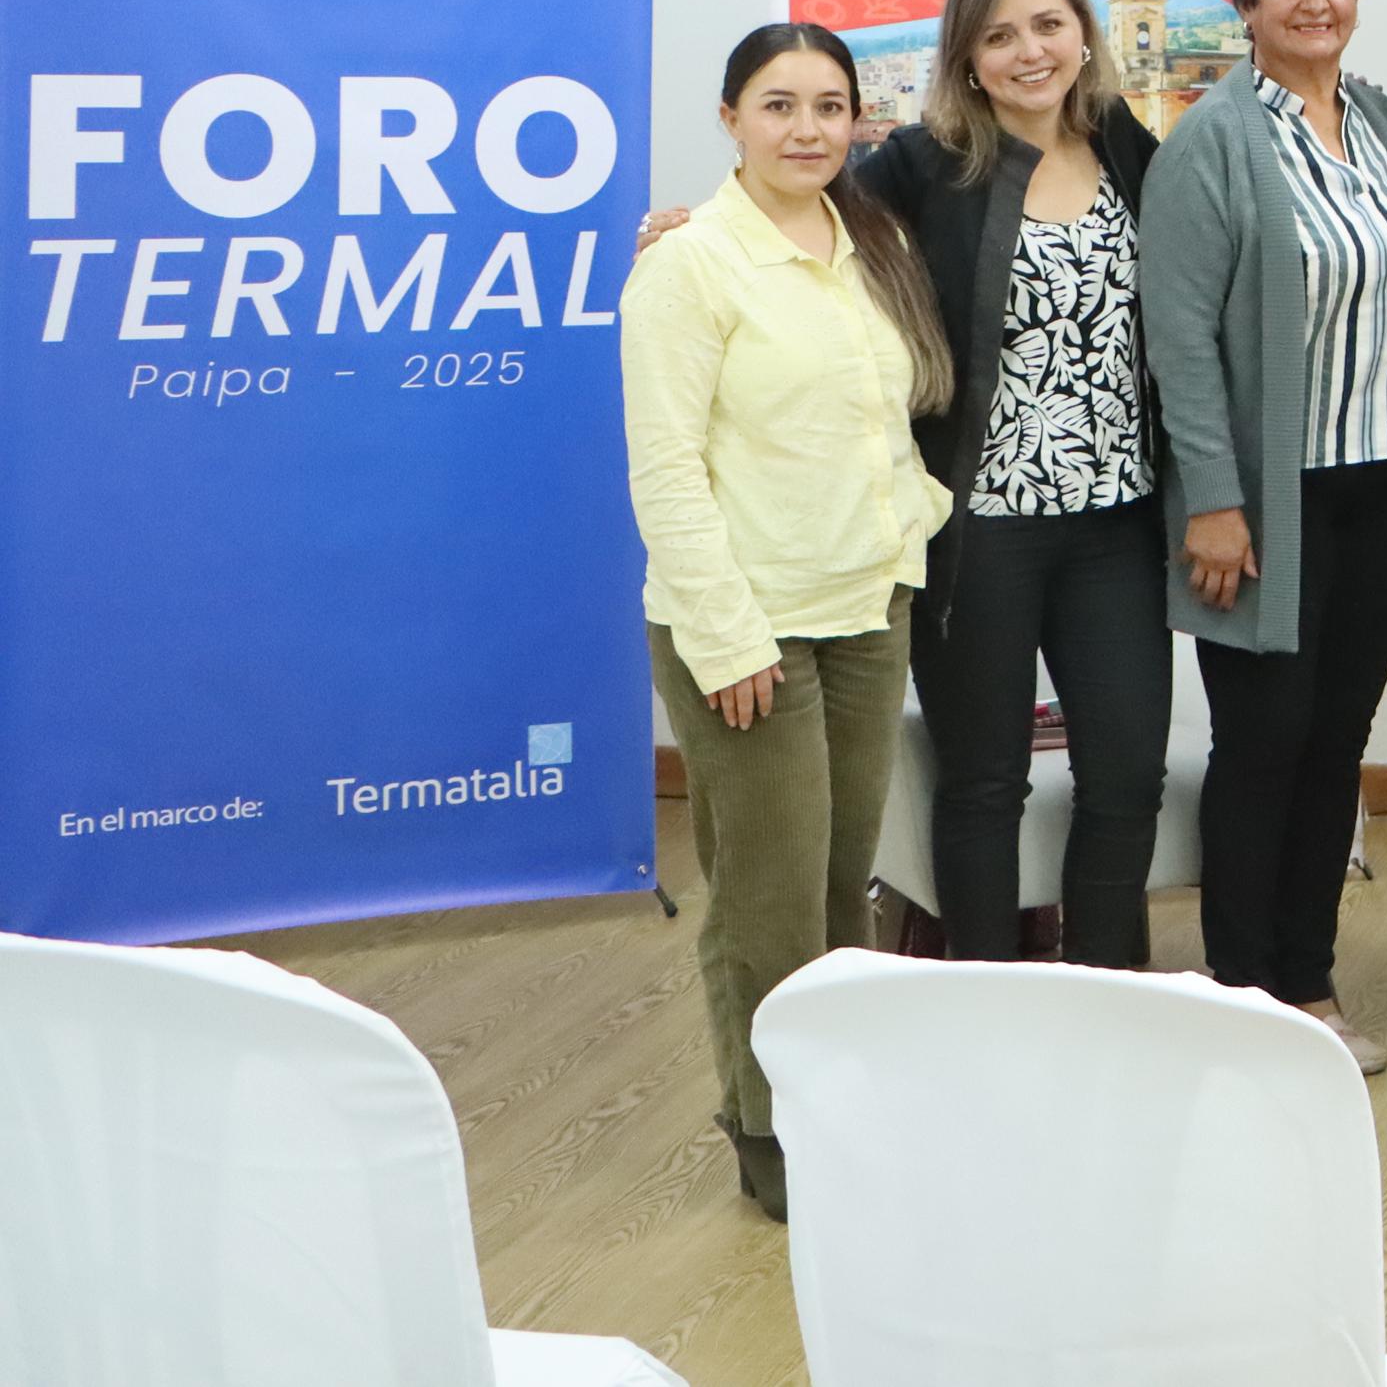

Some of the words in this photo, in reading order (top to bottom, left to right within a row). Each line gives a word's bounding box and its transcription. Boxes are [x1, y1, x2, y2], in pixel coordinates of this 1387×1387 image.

[28, 73, 618, 220] FORO
[28, 230, 616, 342] TERMAL
[128, 360, 291, 407] Paipa
[400, 350, 526, 389] 2025
[326, 759, 564, 815] Termatalia
[59, 812, 94, 837] En
[100, 807, 125, 832] el
[131, 805, 217, 830] marco
[222, 797, 264, 821] de:
